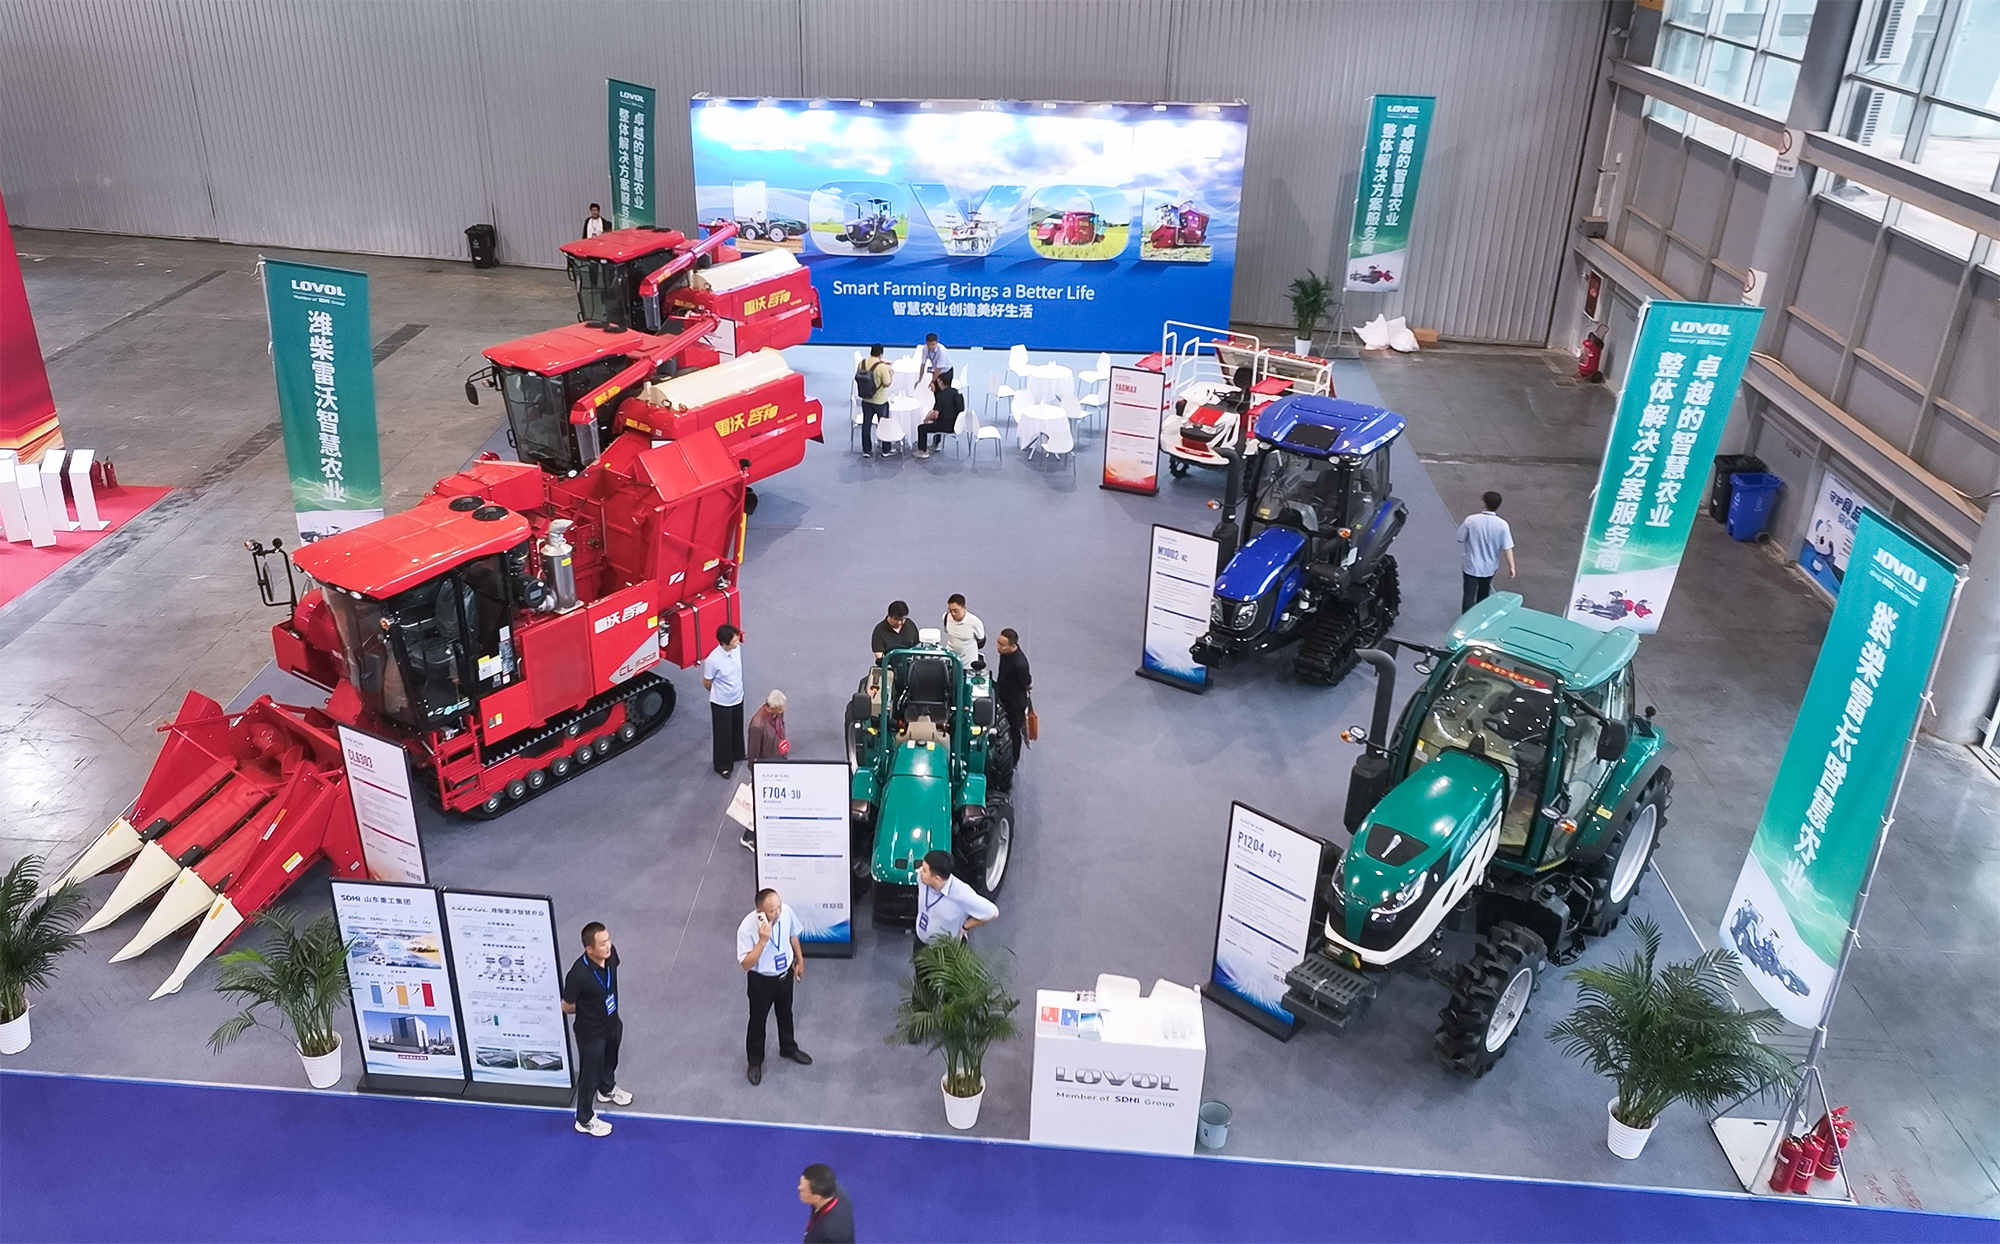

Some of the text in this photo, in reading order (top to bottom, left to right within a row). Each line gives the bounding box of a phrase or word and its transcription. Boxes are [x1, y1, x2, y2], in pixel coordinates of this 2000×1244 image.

[619, 90, 646, 103] LOVOL
[1386, 105, 1420, 113] LOVOL
[1384, 123, 1417, 227] 卓越的智慧农业
[1359, 122, 1399, 255] 整体解决方案服务商
[291, 279, 347, 297] LOVOL
[832, 280, 1095, 301] Smart Farming Brings a Better Life
[892, 301, 1034, 319] 智慧农业创造美好生活
[1670, 320, 1732, 336] LOVOL
[307, 309, 347, 504] 潍柴雷沃智慧农业
[1645, 354, 1723, 529] 卓越的智慧农业
[1595, 351, 1688, 573] 整体解决方案服务商
[1055, 1066, 1179, 1091] LOVOL
[1056, 1091, 1097, 1102] Member
[1114, 1095, 1140, 1104] SDHI
[1144, 1098, 1176, 1108] Group
